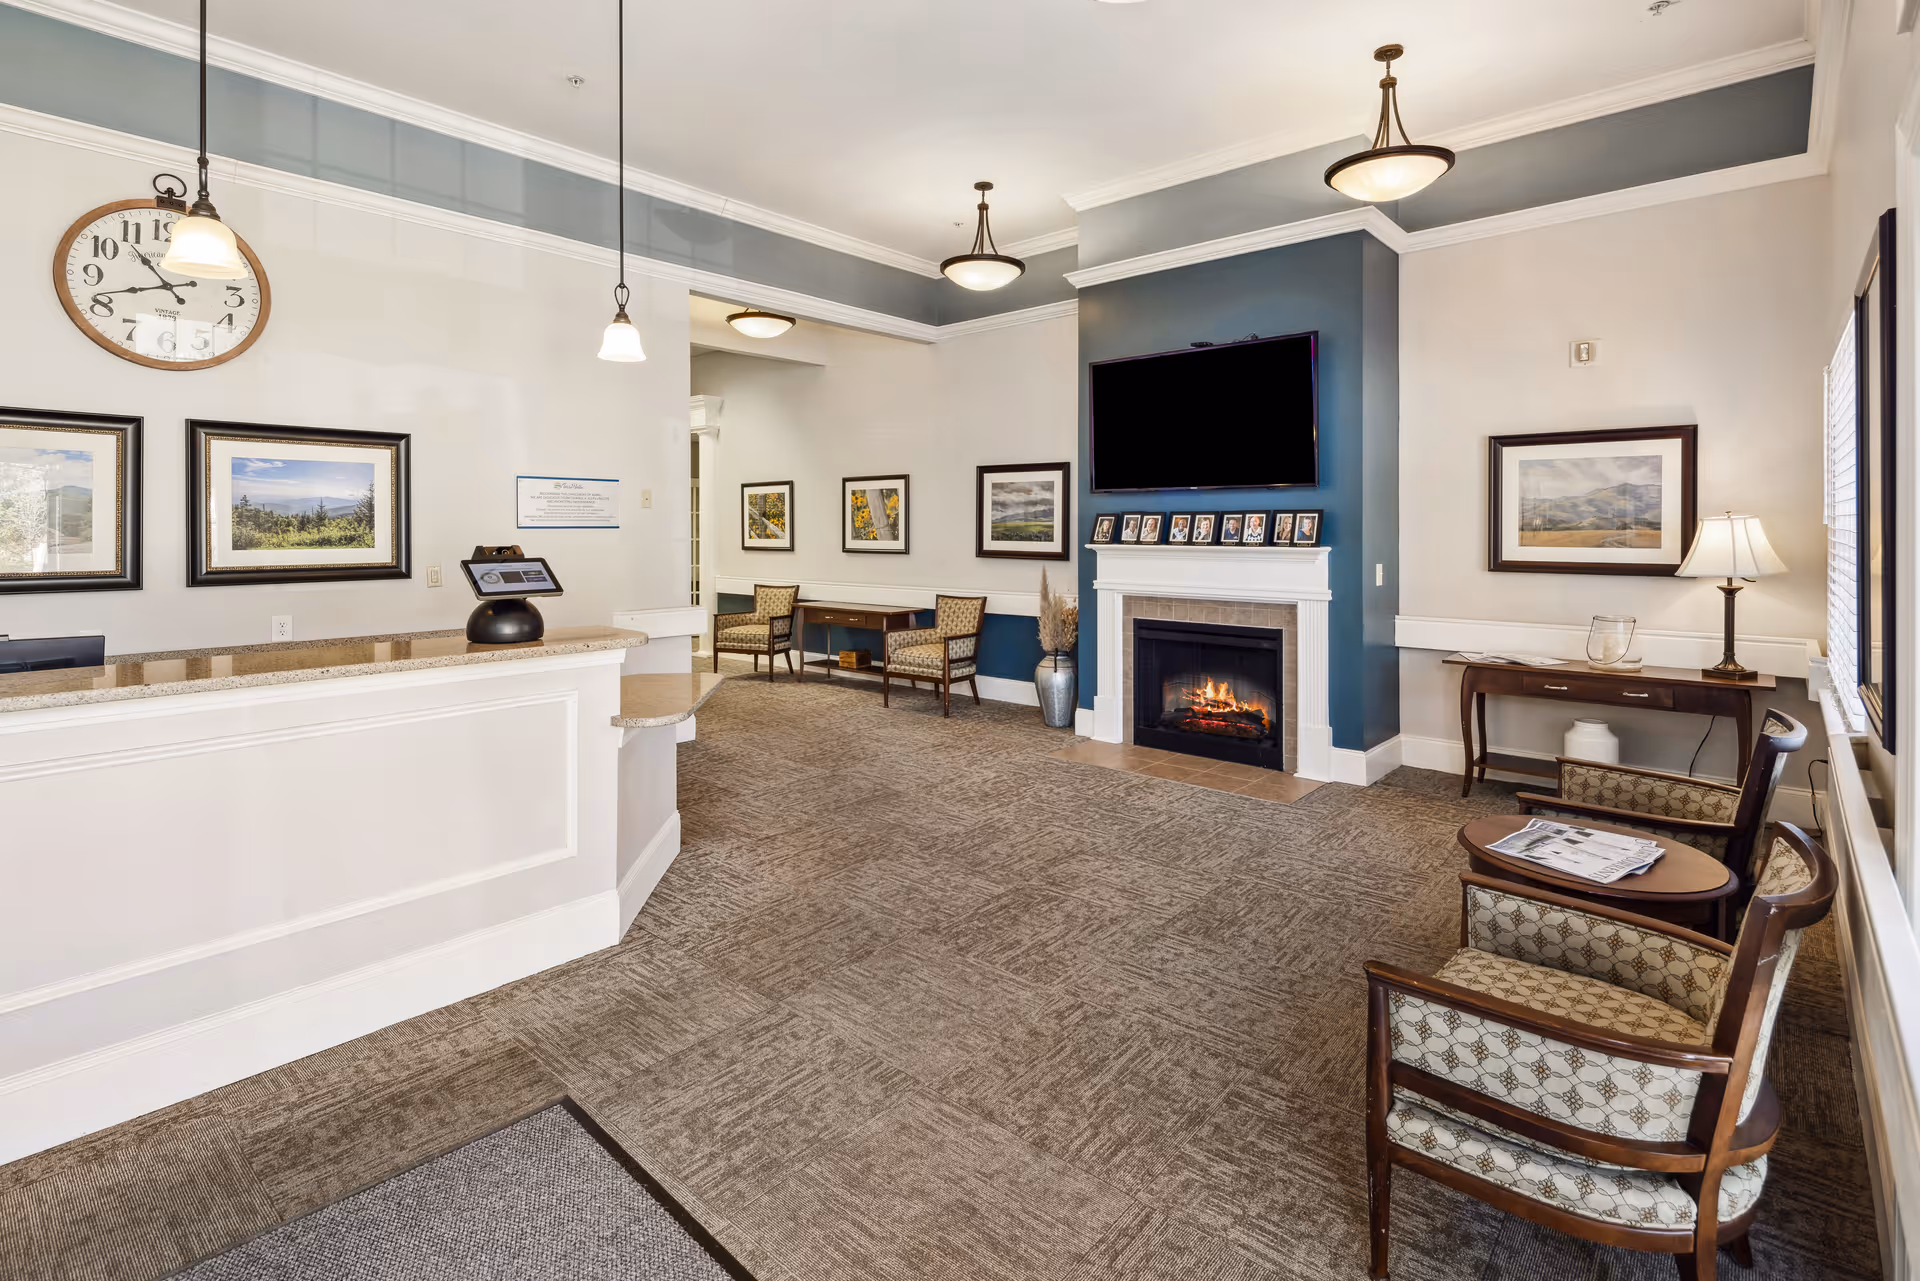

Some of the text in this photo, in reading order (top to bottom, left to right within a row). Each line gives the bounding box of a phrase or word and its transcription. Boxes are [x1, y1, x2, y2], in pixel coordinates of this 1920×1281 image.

[120, 220, 142, 245] 11
[91, 235, 119, 260] 10
[82, 263, 104, 286] 9
[89, 293, 114, 317] 8
[224, 285, 245, 308] 3
[154, 308, 181, 316] VINTAGE
[212, 313, 238, 333] 4
[122, 318, 141, 341] 7
[190, 328, 210, 350] 5
[156, 331, 177, 353] 6
